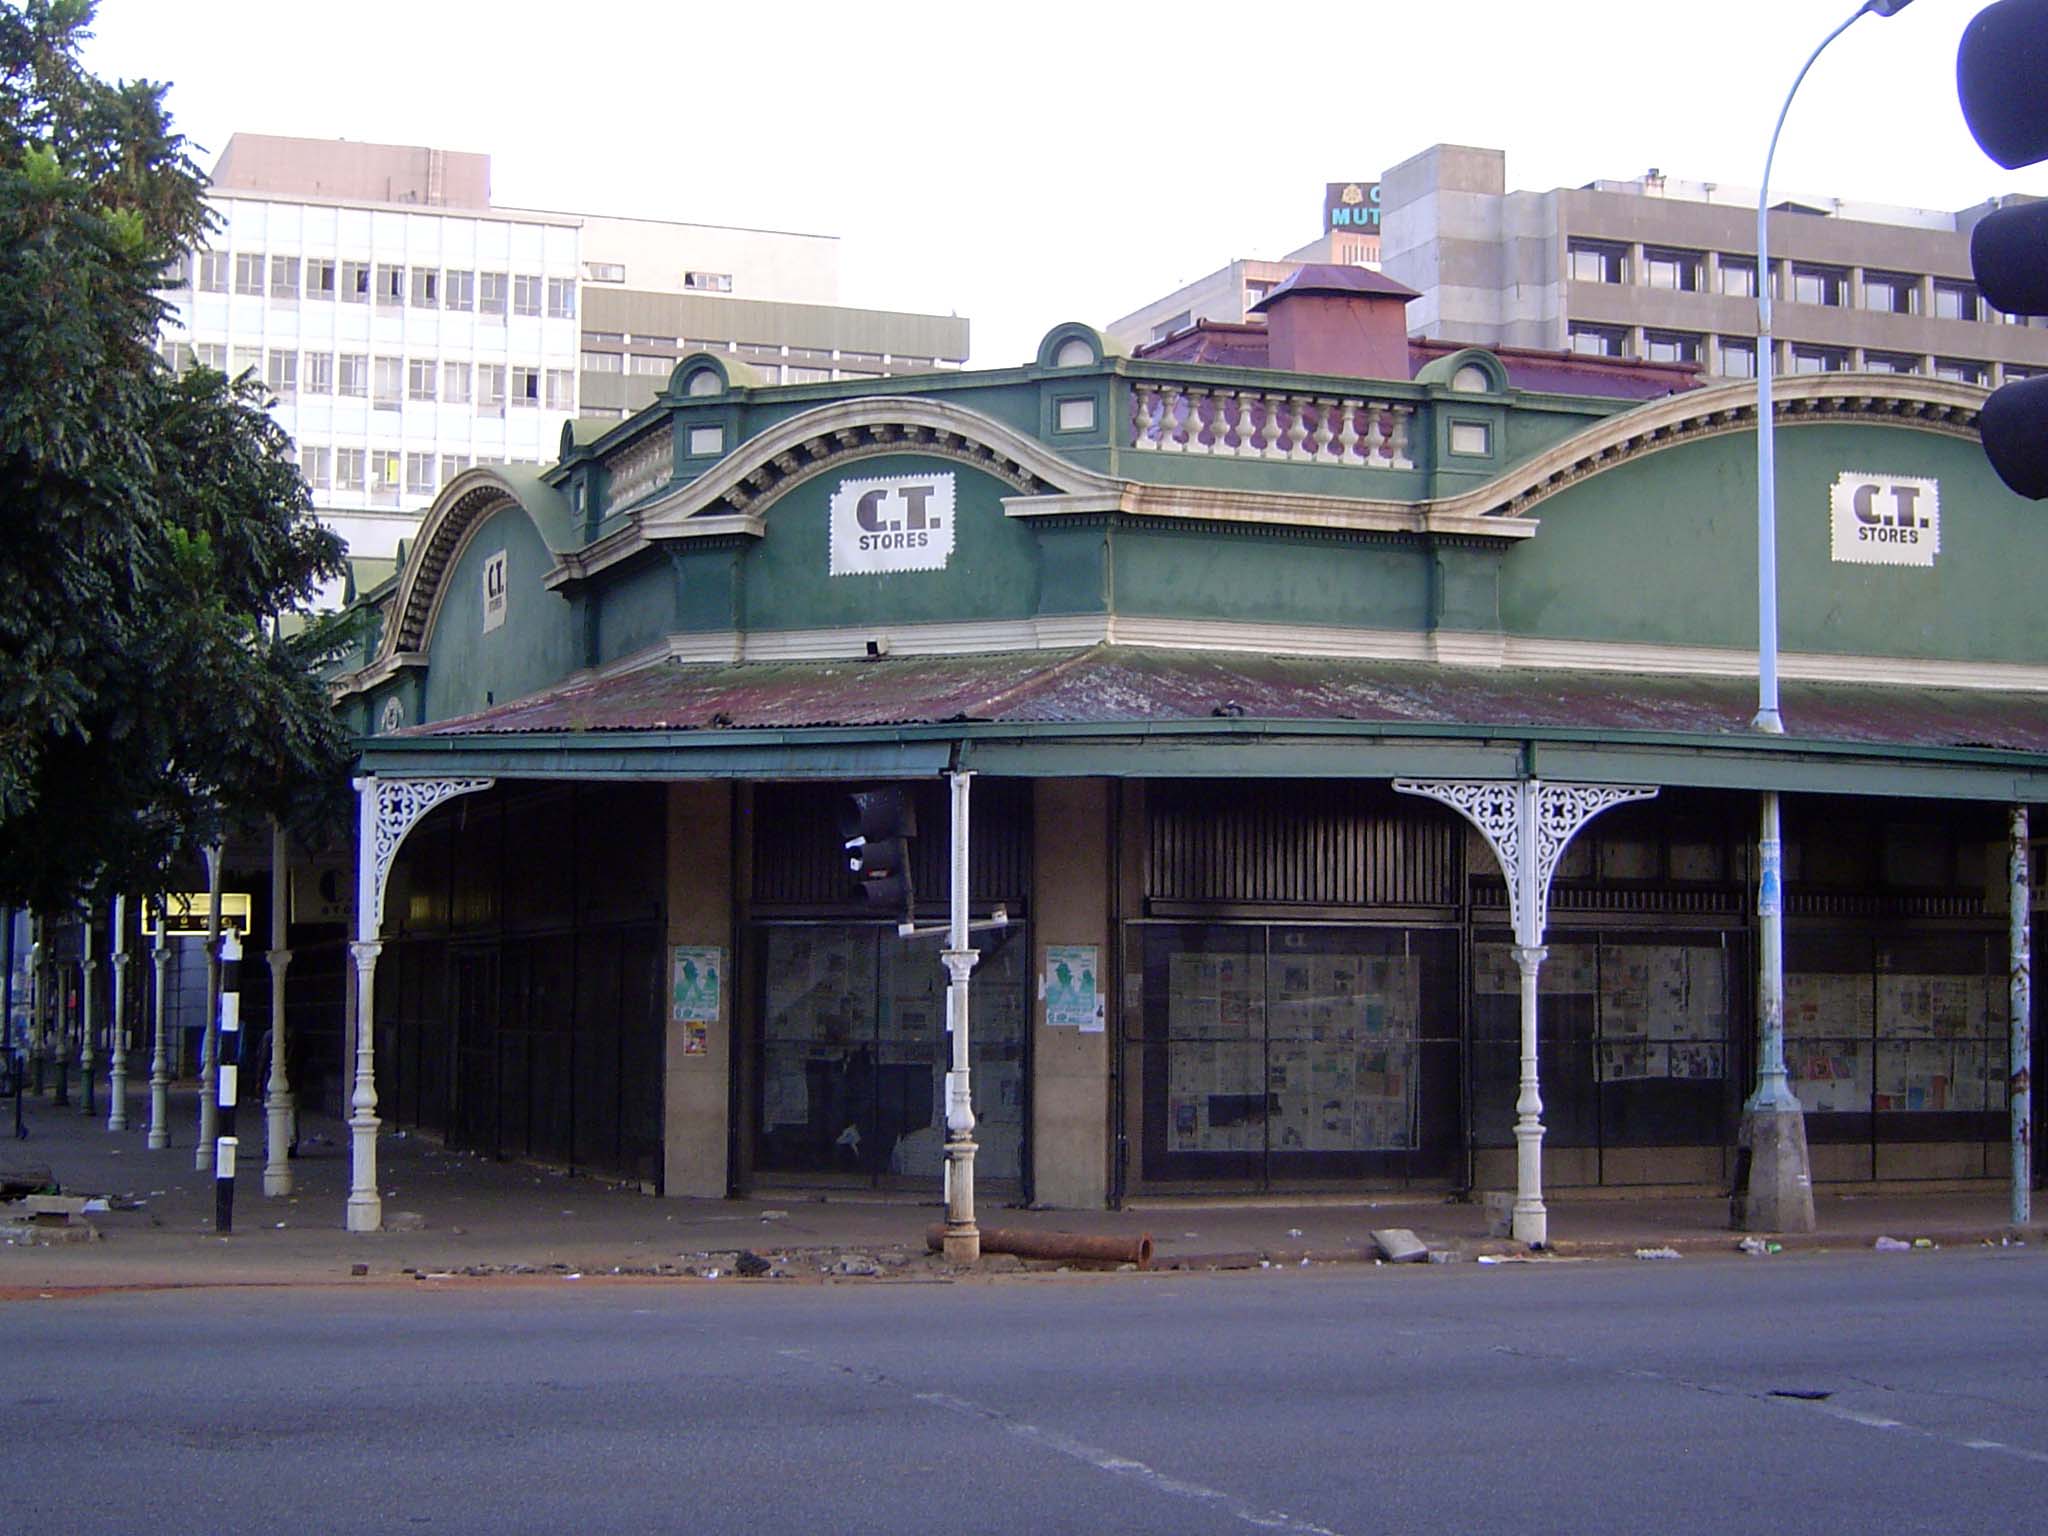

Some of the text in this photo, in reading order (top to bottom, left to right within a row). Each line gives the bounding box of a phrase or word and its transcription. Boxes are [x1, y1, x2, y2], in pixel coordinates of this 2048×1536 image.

[856, 485, 941, 533] C.T.
[1853, 484, 1929, 528] C.T.
[859, 532, 928, 550] STORES
[1858, 527, 1919, 544] STORES
[488, 559, 504, 598] C.T.
